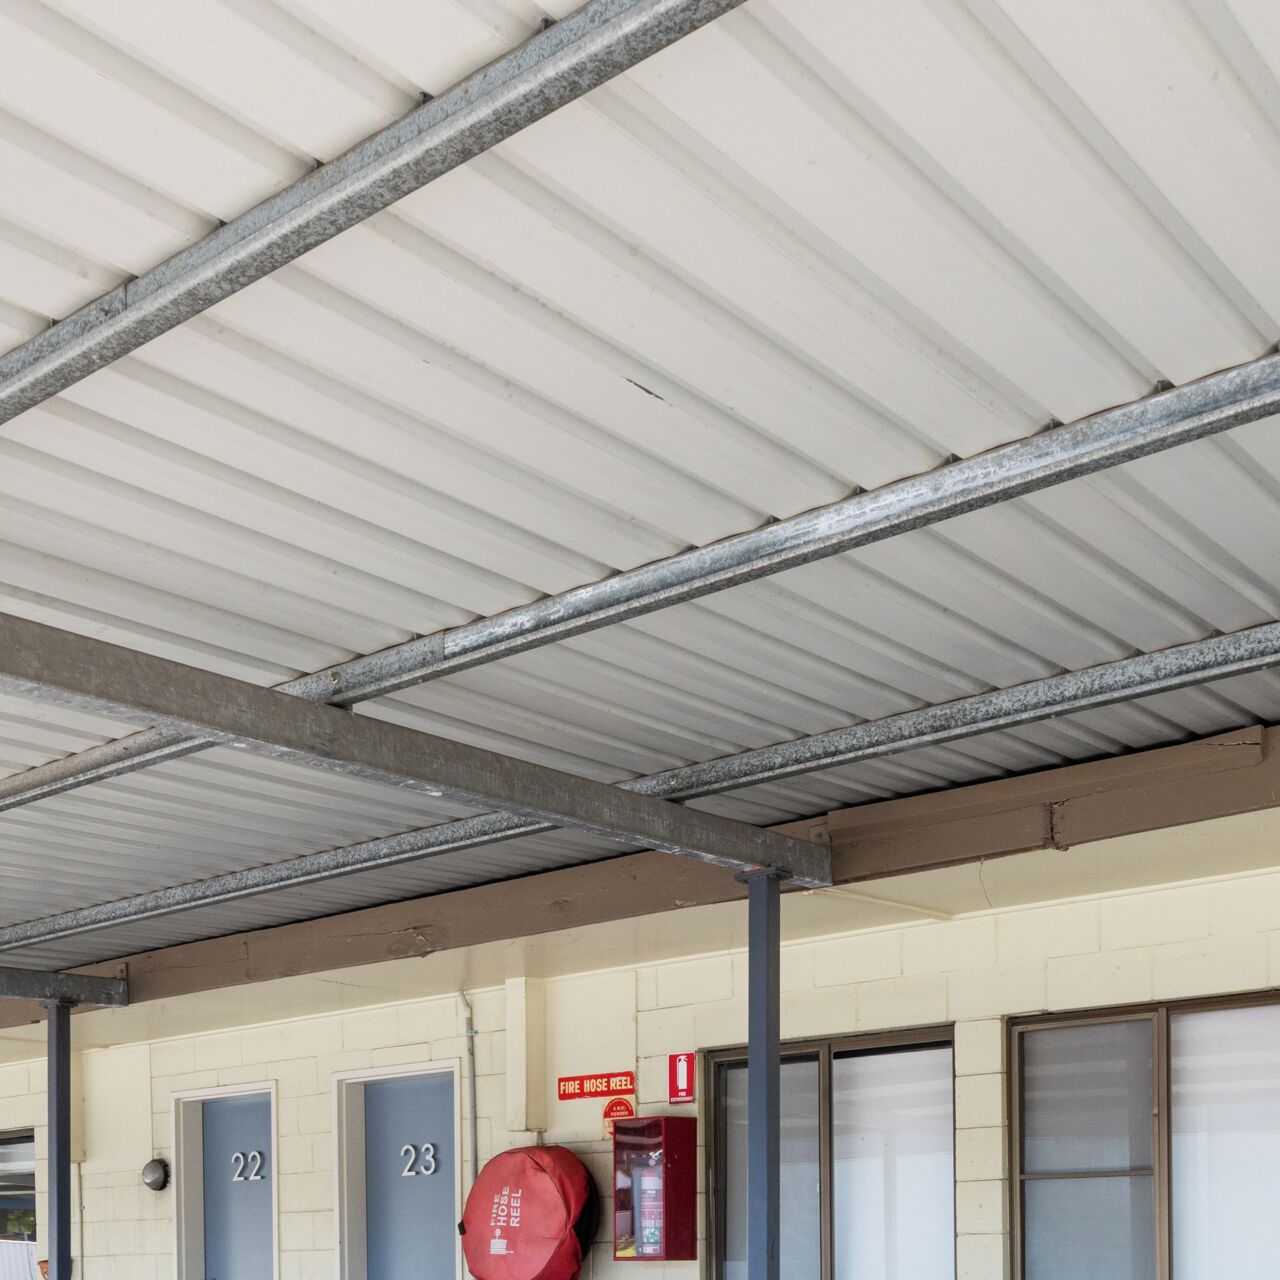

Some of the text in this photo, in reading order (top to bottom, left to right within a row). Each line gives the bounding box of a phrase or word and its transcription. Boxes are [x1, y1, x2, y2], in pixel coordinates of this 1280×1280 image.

[560, 1076, 633, 1095] FIRE HOSE REEL
[231, 1151, 263, 1182] 22
[400, 1143, 437, 1177] 23
[490, 1193, 501, 1226] FIRE
[496, 1185, 510, 1226] HOSE
[510, 1188, 522, 1227] REEL
